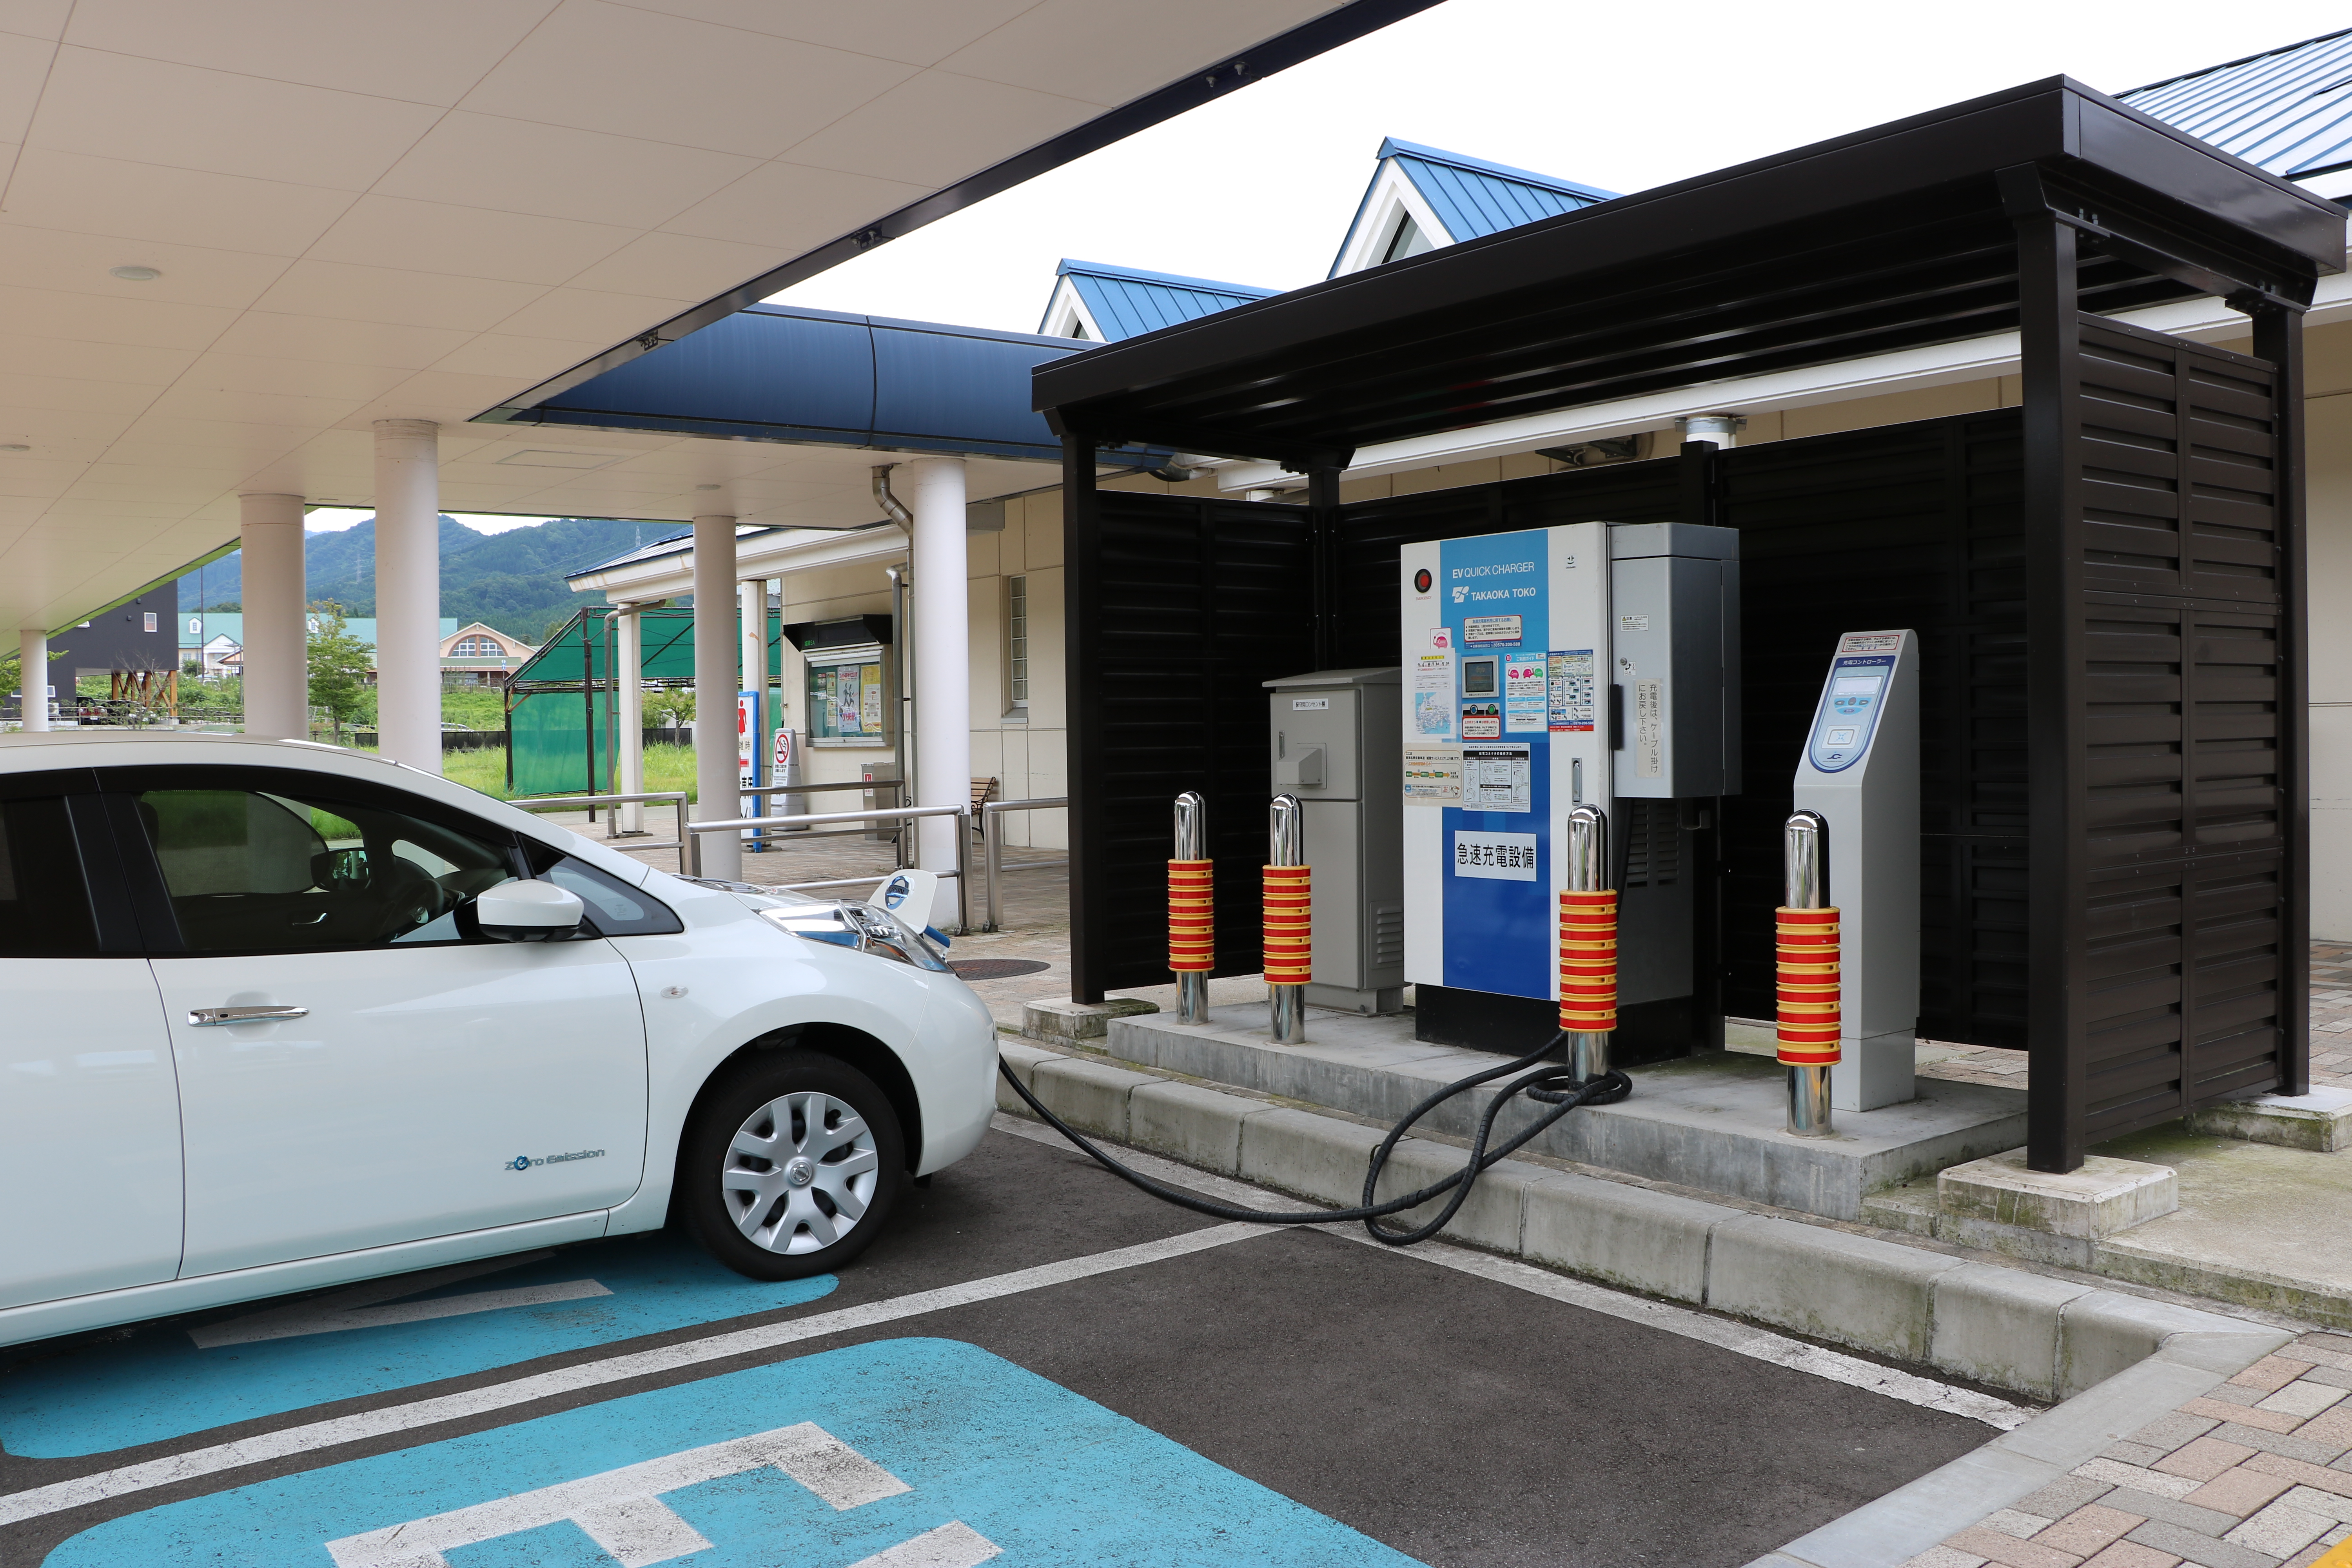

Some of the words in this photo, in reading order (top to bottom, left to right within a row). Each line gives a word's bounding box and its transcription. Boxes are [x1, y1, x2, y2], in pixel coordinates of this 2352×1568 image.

[1452, 568, 1463, 579] EV
[1465, 565, 1491, 578] QUICK
[1492, 561, 1535, 575] CHARGER
[1471, 589, 1510, 601] TAKAOKA
[1512, 587, 1536, 598] TOKO
[1639, 684, 1647, 746] にお戻し下さい。
[1650, 684, 1658, 773] 充電後は、ケーブル掛け
[1457, 842, 1534, 869] 急速充電設備
[546, 1149, 605, 1164] Emission
